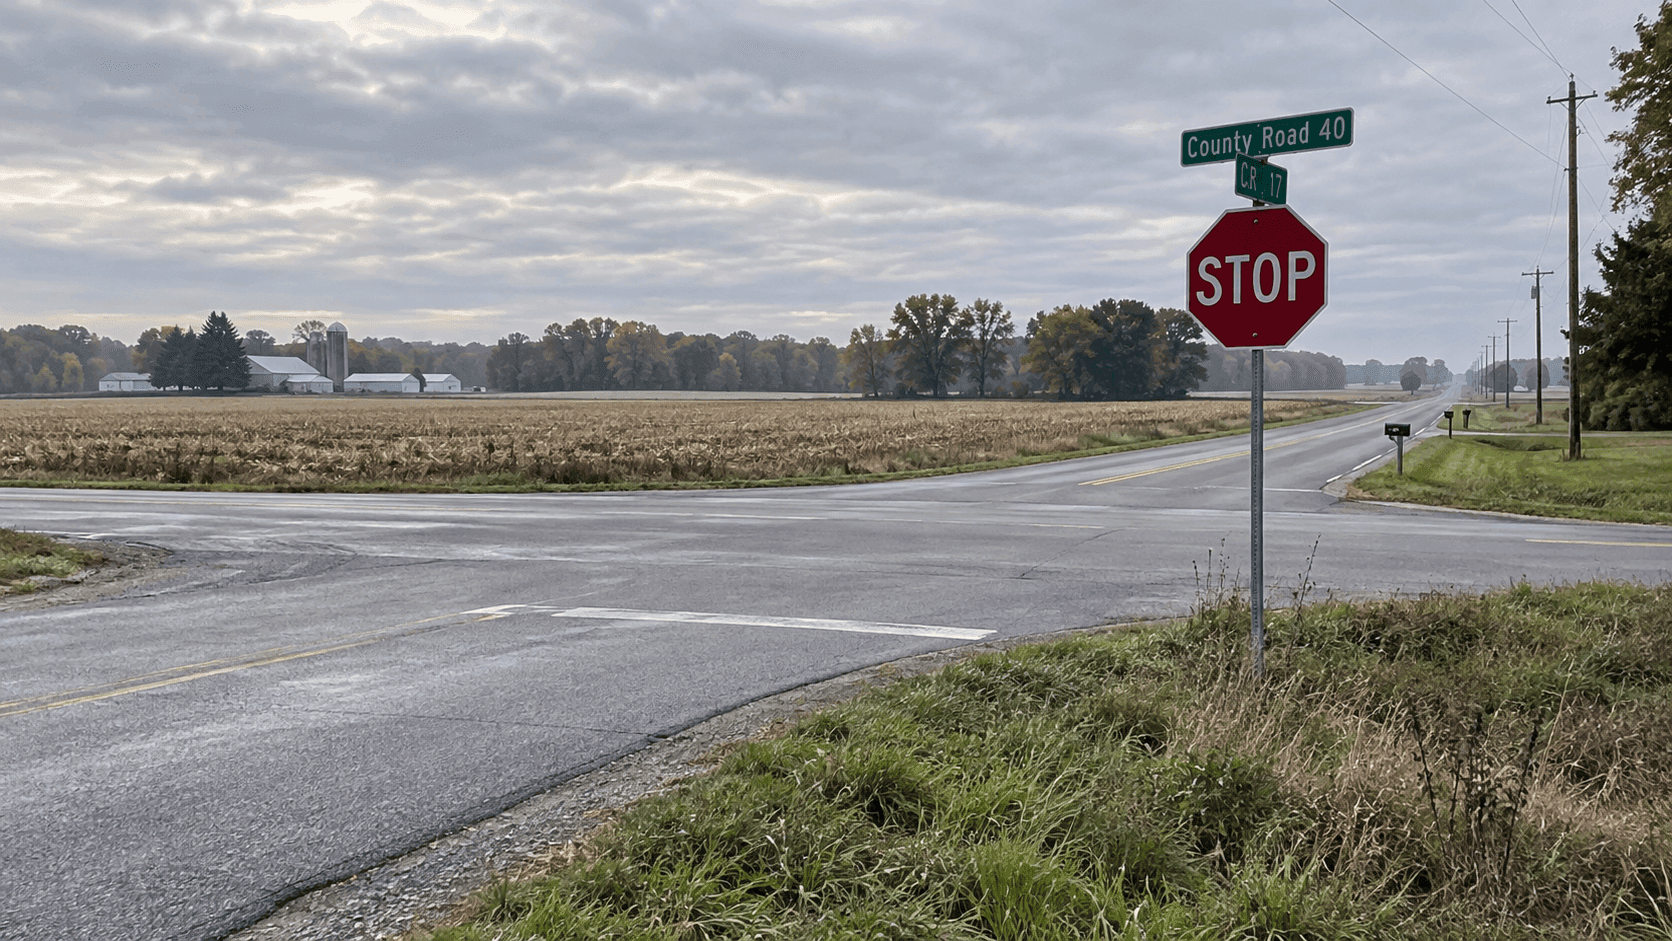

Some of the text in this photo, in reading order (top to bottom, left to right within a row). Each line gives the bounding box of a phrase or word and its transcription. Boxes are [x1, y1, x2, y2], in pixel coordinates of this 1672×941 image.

[1187, 116, 1345, 158] County Road 40
[1270, 172, 1282, 198] 17
[1196, 250, 1316, 306] STOP
